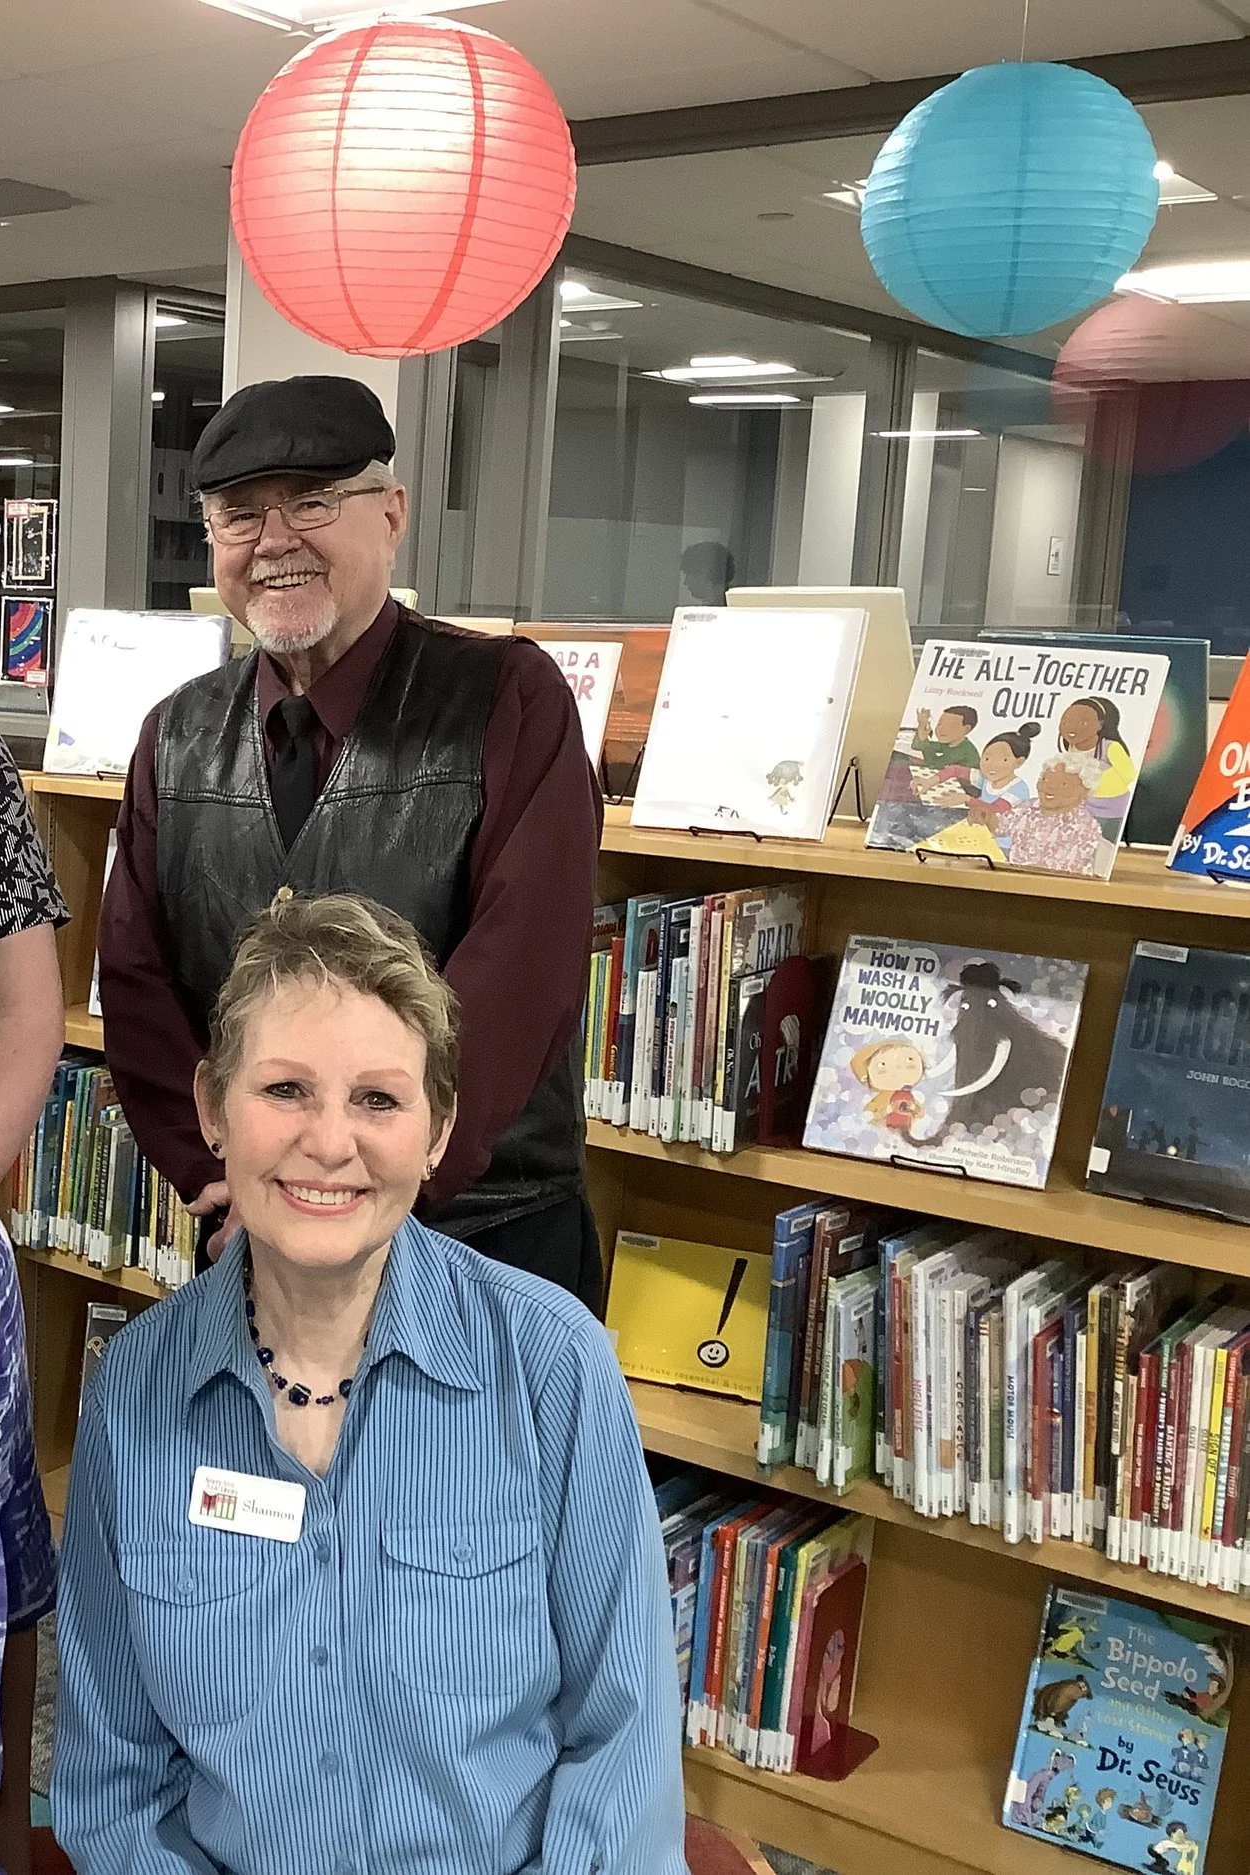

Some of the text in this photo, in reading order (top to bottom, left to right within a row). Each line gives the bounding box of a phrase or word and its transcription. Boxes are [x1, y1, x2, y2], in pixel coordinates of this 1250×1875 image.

[553, 652, 599, 668] AD A
[929, 647, 1149, 695] THE ALL-TOGETHER
[566, 674, 595, 700] OR
[947, 687, 983, 698] Rockwell
[992, 688, 1061, 718] QUILT
[1182, 834, 1202, 854] By
[756, 924, 793, 972] BEAR
[870, 951, 935, 973] HOW TO
[858, 969, 919, 991] WASH A
[860, 989, 932, 1014] WOOLLY
[843, 1006, 939, 1036] MAMMOTH
[727, 1048, 735, 1057] Oh
[1186, 1070, 1250, 1089] JOHN ROCC
[953, 1147, 1032, 1166] Michelle Robinson
[976, 1160, 994, 1169] Kate
[998, 1164, 1030, 1177] Hindley
[640, 1364, 671, 1376] krouse
[674, 1371, 718, 1386] rosenthal
[1007, 1410, 1015, 1439] MOUSE
[1164, 1425, 1175, 1465] MAKING
[1188, 1425, 1197, 1450] OLIVE
[1207, 1432, 1219, 1477] SIGN OFF
[1161, 1474, 1171, 1511] FRIEND
[242, 1499, 294, 1521] Shannon
[1127, 1626, 1155, 1644] The
[1107, 1637, 1198, 1683] Bippolo
[1100, 1666, 1161, 1702] Seed
[1117, 1736, 1134, 1754] by
[1096, 1746, 1201, 1806] Dr. Seuss
